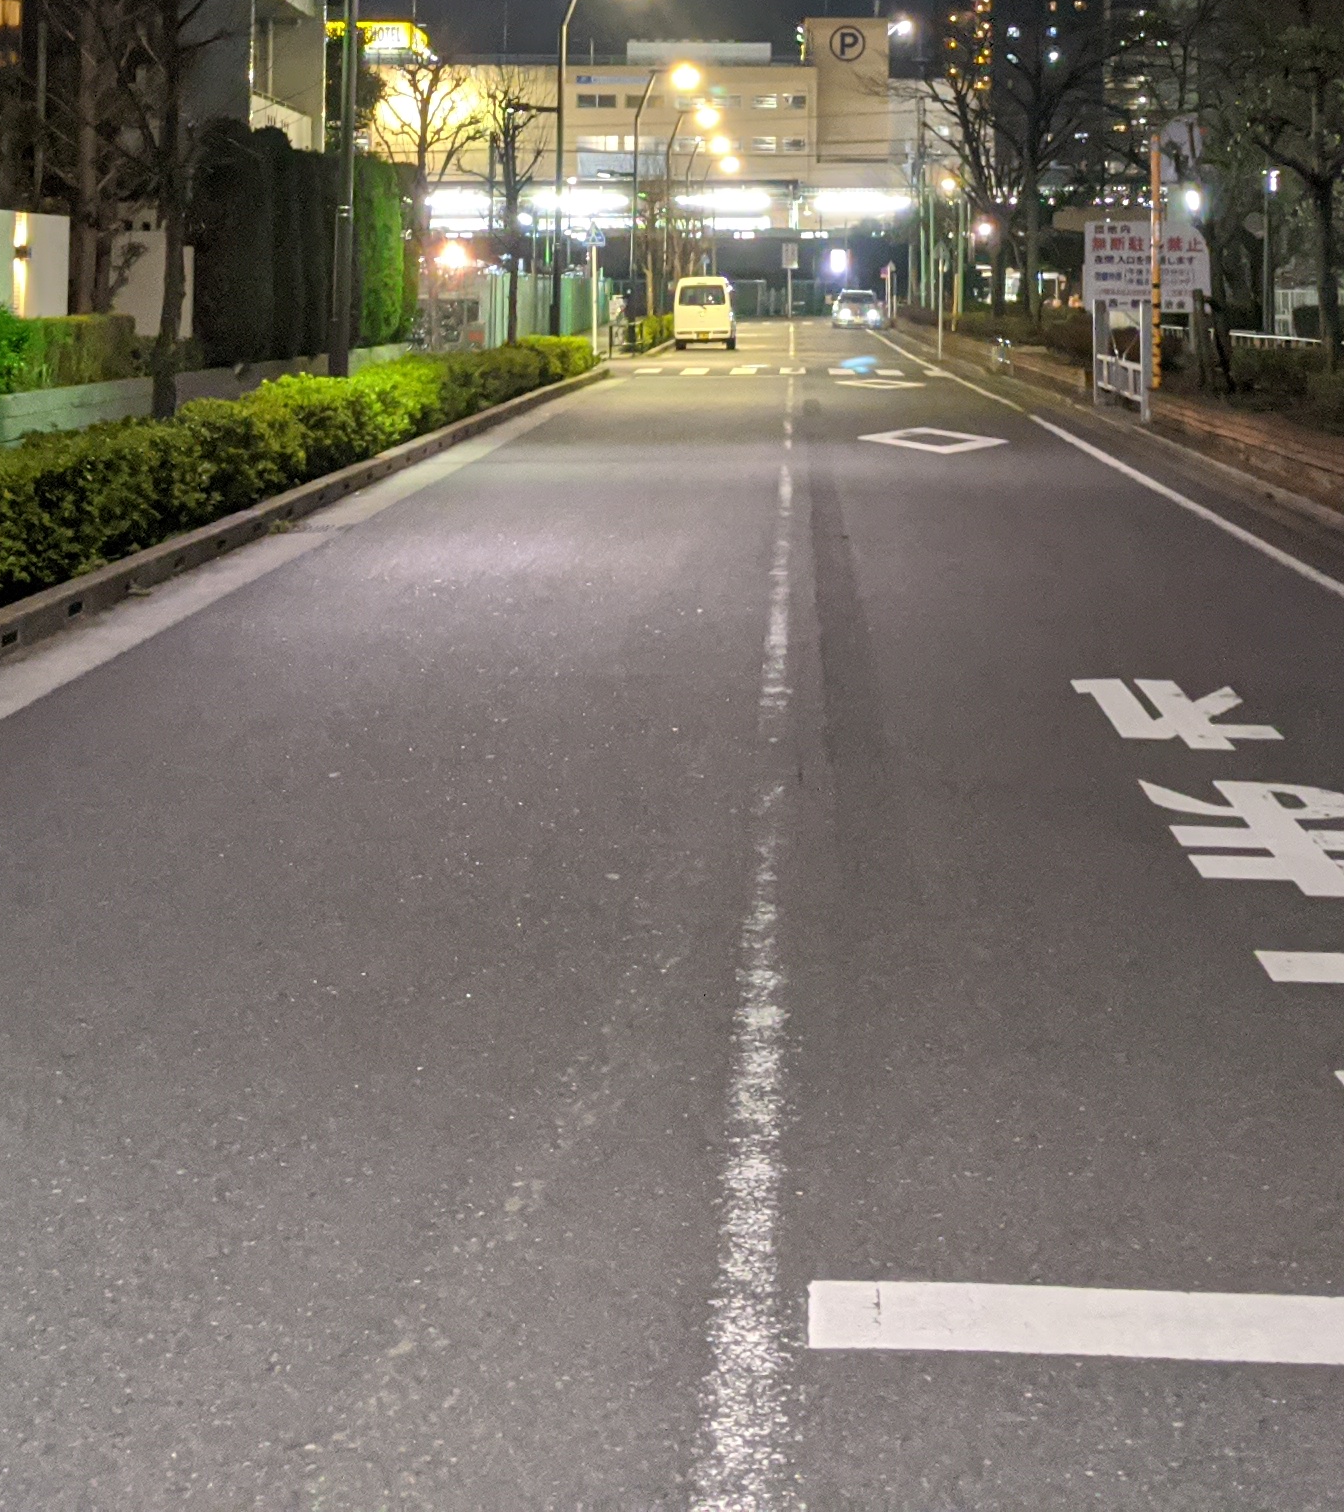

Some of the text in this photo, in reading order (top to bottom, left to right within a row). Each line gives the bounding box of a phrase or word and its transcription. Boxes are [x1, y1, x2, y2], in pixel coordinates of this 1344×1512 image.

[1092, 236, 1203, 252] 無断駐禁止
